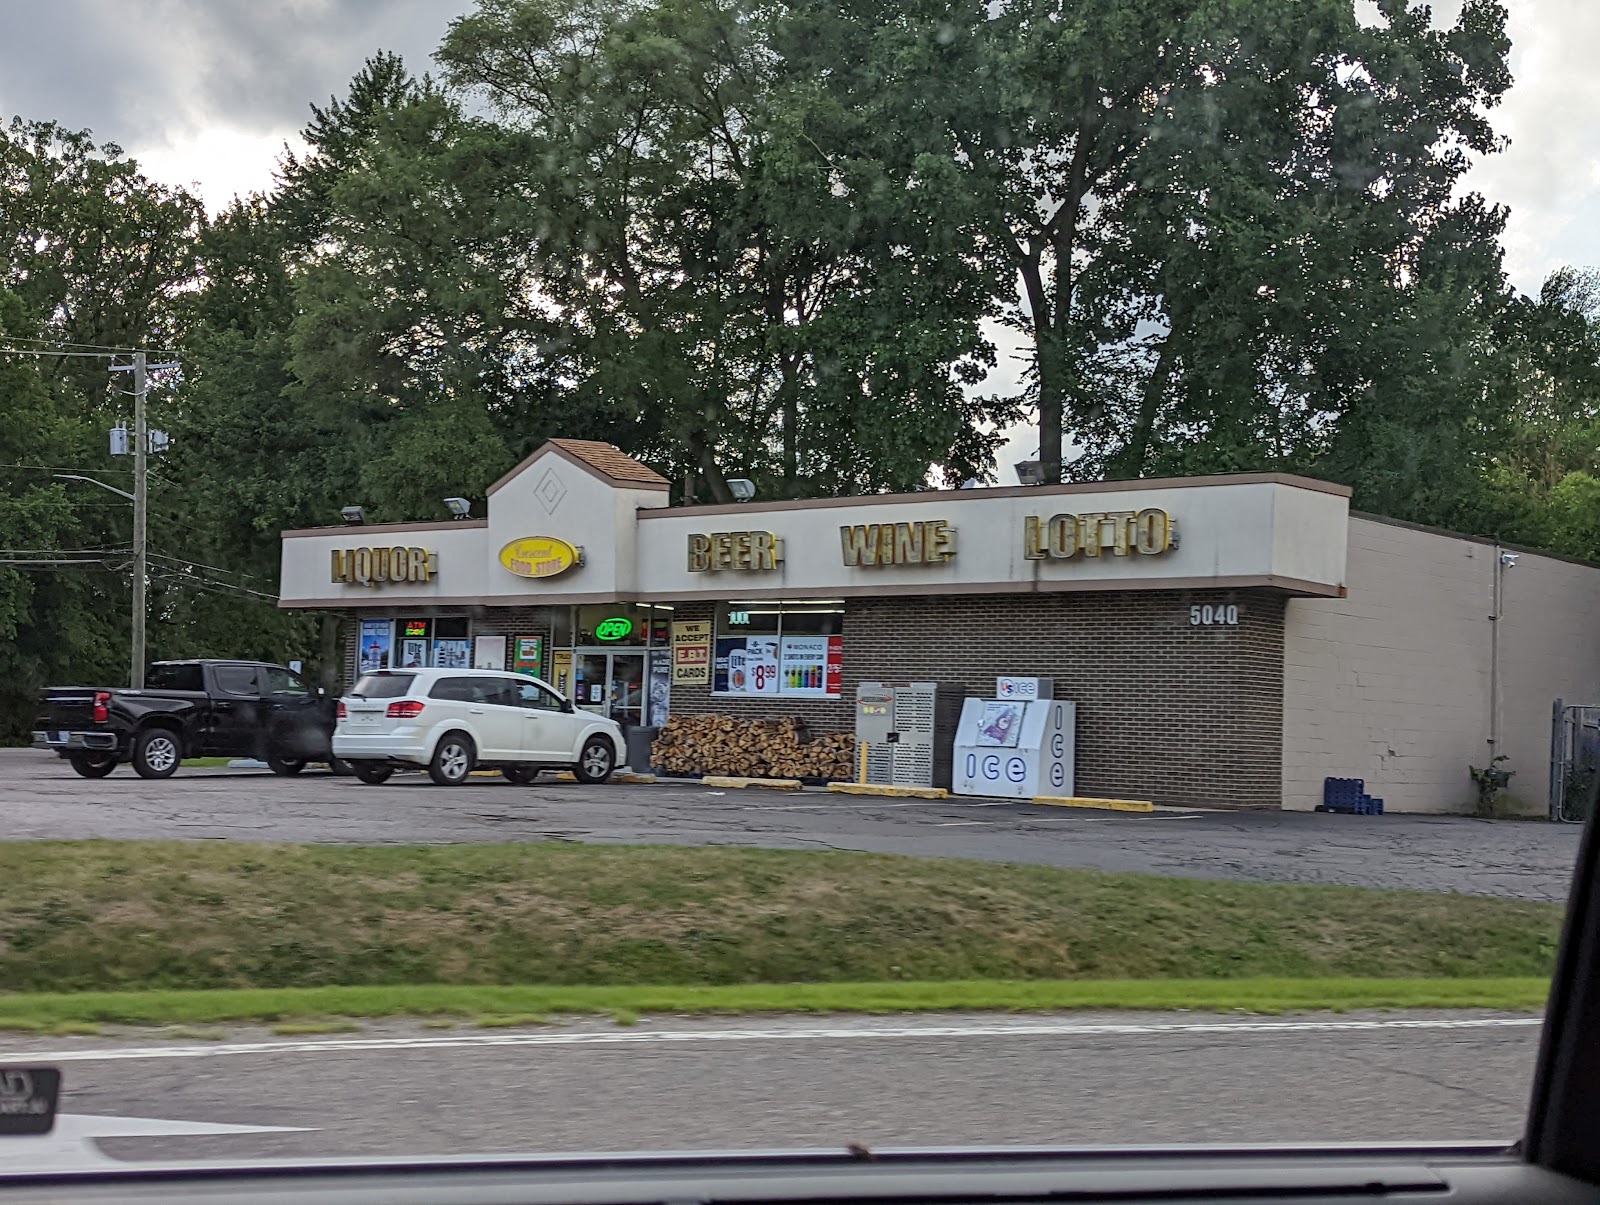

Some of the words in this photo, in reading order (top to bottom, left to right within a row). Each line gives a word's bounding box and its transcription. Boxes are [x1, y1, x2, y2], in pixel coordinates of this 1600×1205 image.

[840, 520, 948, 567] WINE
[1024, 508, 1169, 560] LOTTO
[687, 530, 777, 572] BEER
[331, 546, 429, 586] LIQUOR
[511, 557, 531, 575] FOOD
[536, 557, 562, 575] STORE
[1190, 604, 1239, 625] 5040
[600, 622, 628, 637] OPEN
[675, 634, 709, 642] ACCEPT
[731, 655, 746, 668] Lite
[676, 667, 706, 678] CARDS
